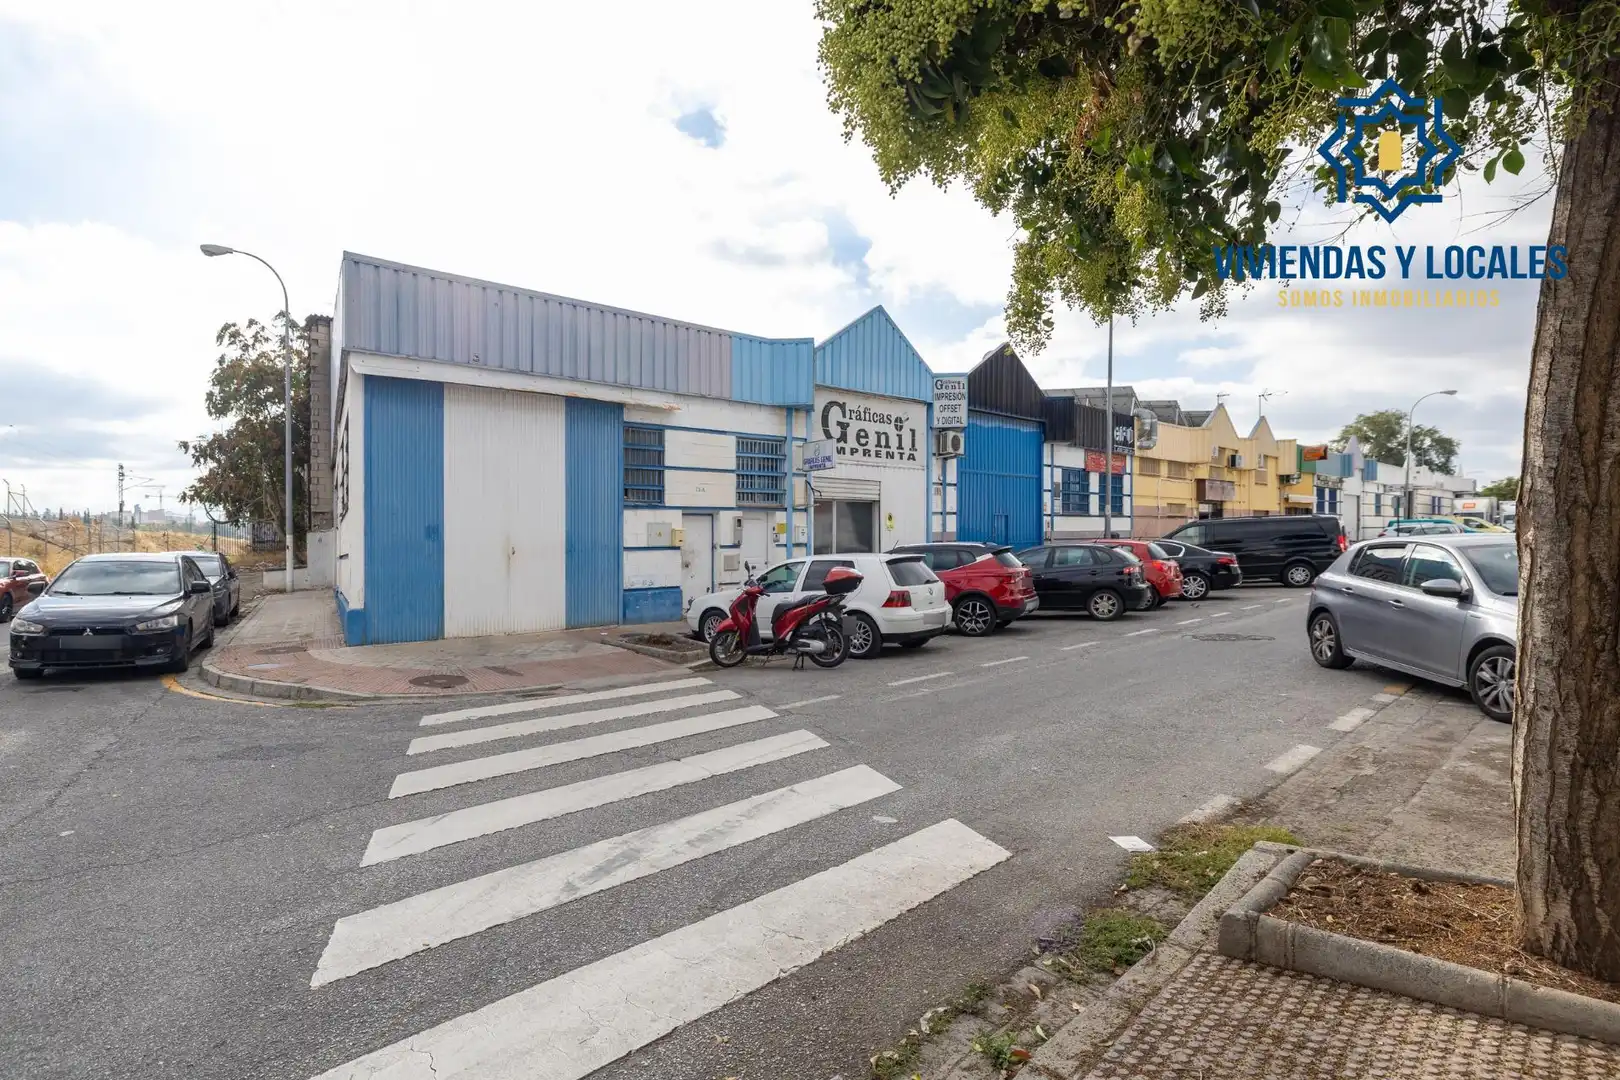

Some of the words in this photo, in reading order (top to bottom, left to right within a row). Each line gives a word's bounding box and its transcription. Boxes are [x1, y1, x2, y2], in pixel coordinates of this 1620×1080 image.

[939, 404, 961, 413] OFFSET
[936, 416, 941, 425] Y
[942, 416, 964, 425] DIGITAL
[836, 446, 916, 461] MPRENTA
